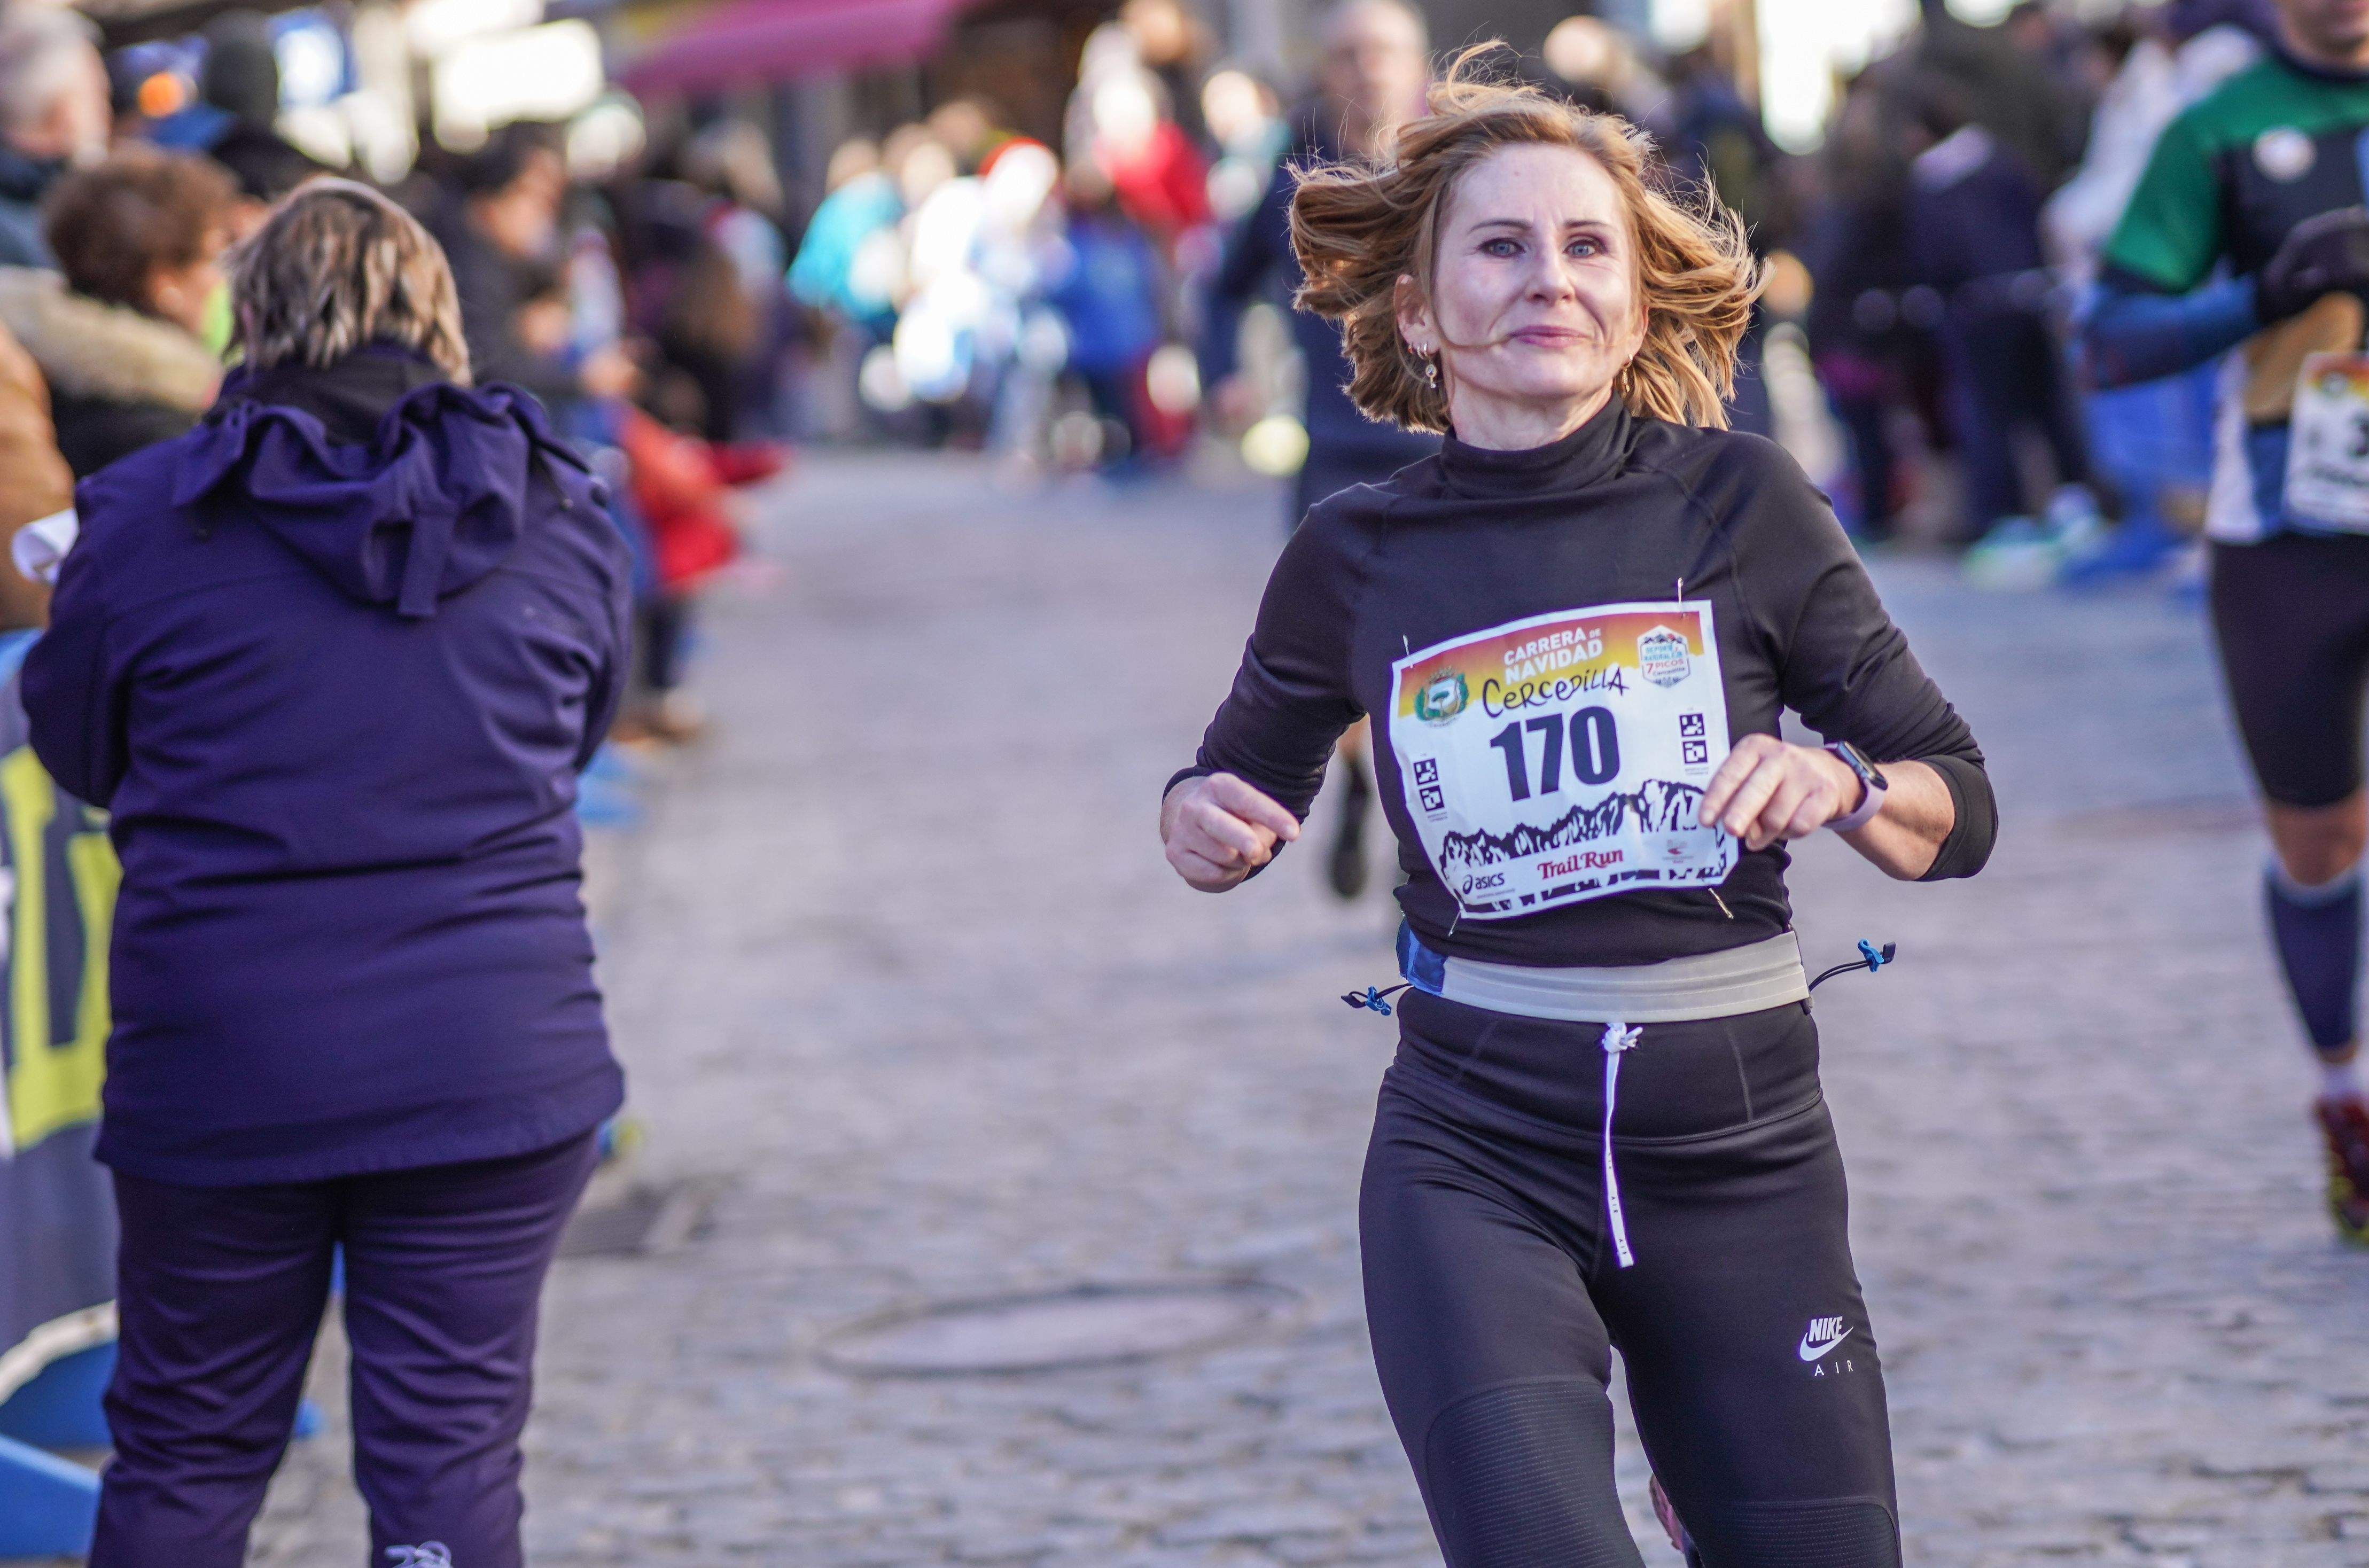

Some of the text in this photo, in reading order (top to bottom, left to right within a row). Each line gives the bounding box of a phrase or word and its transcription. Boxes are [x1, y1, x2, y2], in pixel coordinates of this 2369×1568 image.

[1504, 627, 1602, 666] CARRERA DE
[1505, 638, 1603, 685] NAVIDAD
[1646, 659, 1684, 674] 7 PICOS
[1490, 706, 1620, 802] 170
[1537, 849, 1624, 880] Trail Run
[1808, 1316, 1843, 1342] NIKE
[1814, 1360, 1853, 1377] AIR
